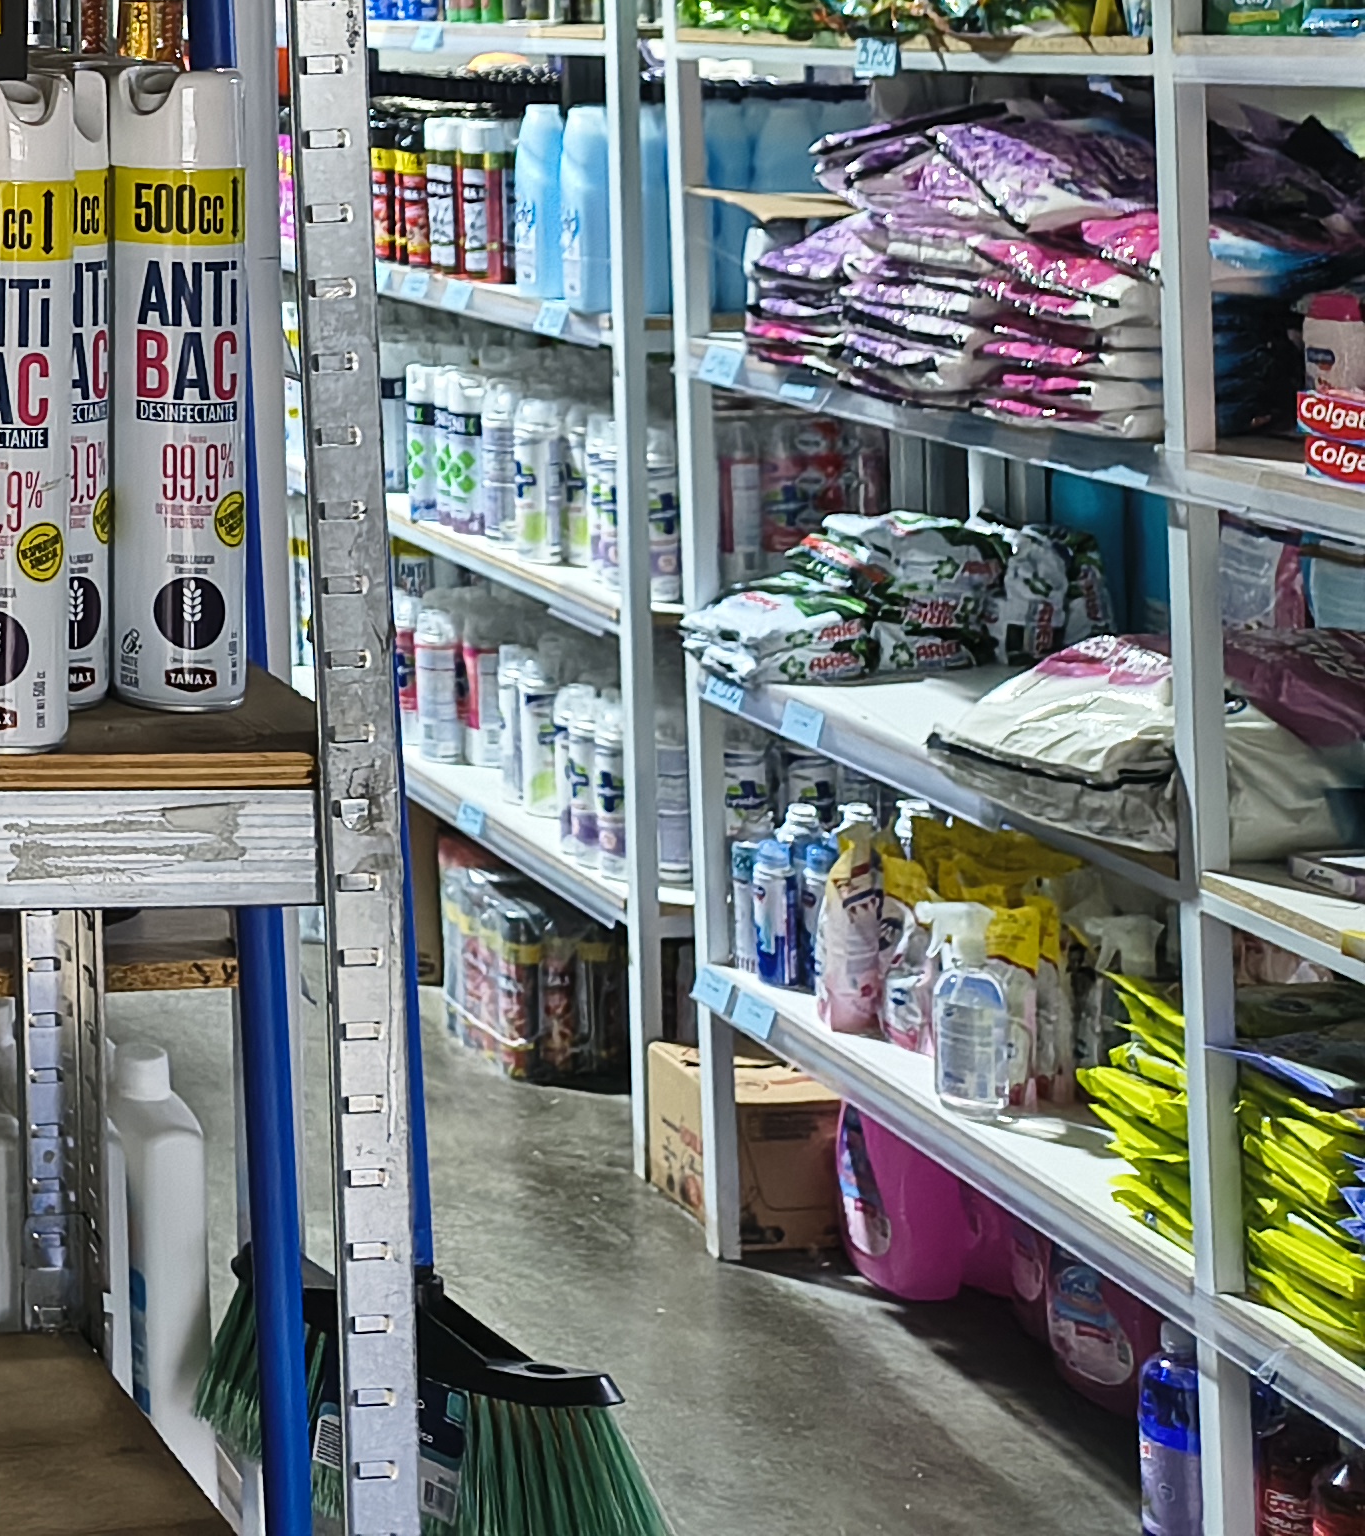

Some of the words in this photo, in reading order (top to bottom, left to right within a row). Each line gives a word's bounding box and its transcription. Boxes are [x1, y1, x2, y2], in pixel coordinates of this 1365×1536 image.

[133, 182, 225, 235] 500cc
[1300, 397, 1365, 431] Colgat
[1309, 440, 1365, 474] Colga
[170, 671, 213, 688] TANAX
